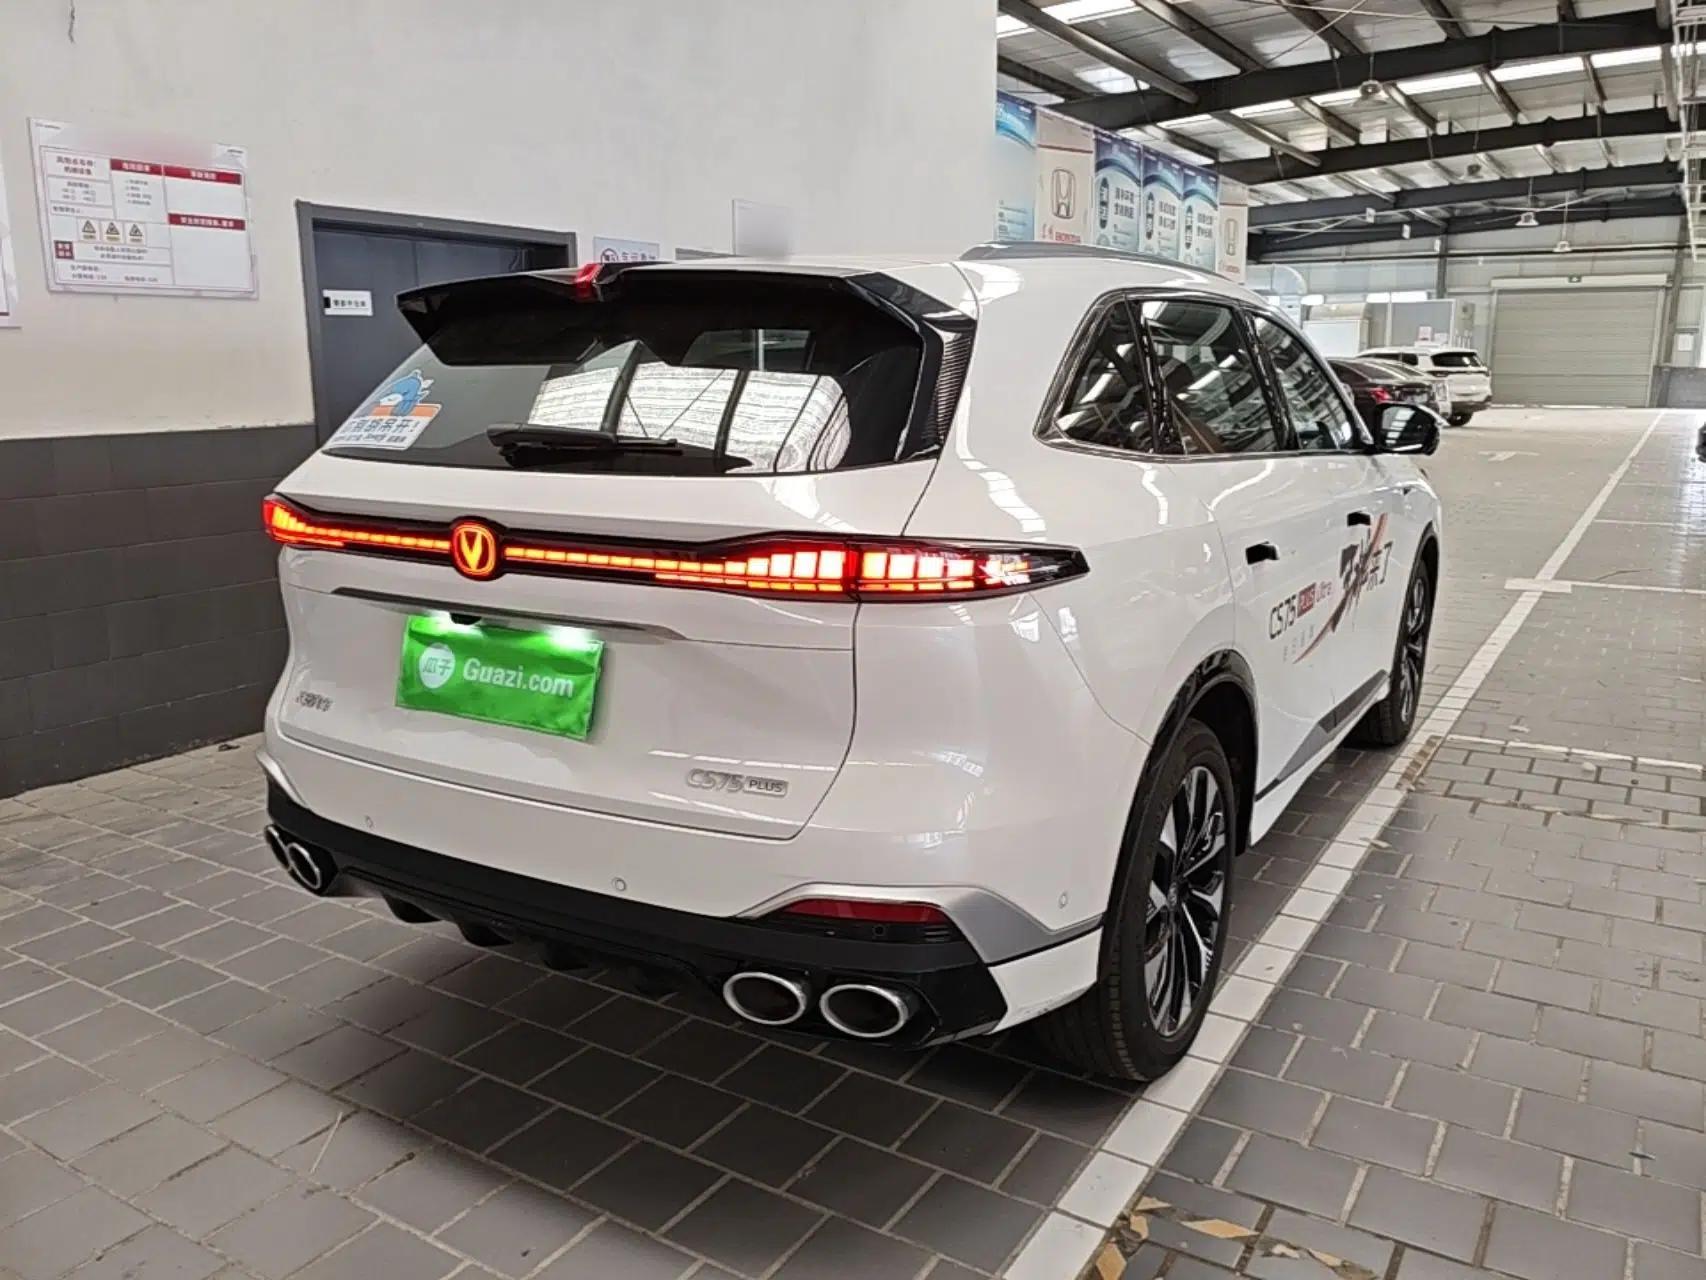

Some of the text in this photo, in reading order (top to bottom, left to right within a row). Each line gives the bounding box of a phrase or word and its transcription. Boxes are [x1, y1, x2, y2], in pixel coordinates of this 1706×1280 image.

[1270, 594, 1296, 640] CS75
[422, 657, 451, 676] 瓜子
[463, 657, 575, 697] Guazi.com
[687, 768, 784, 793] CS75 PLUS
